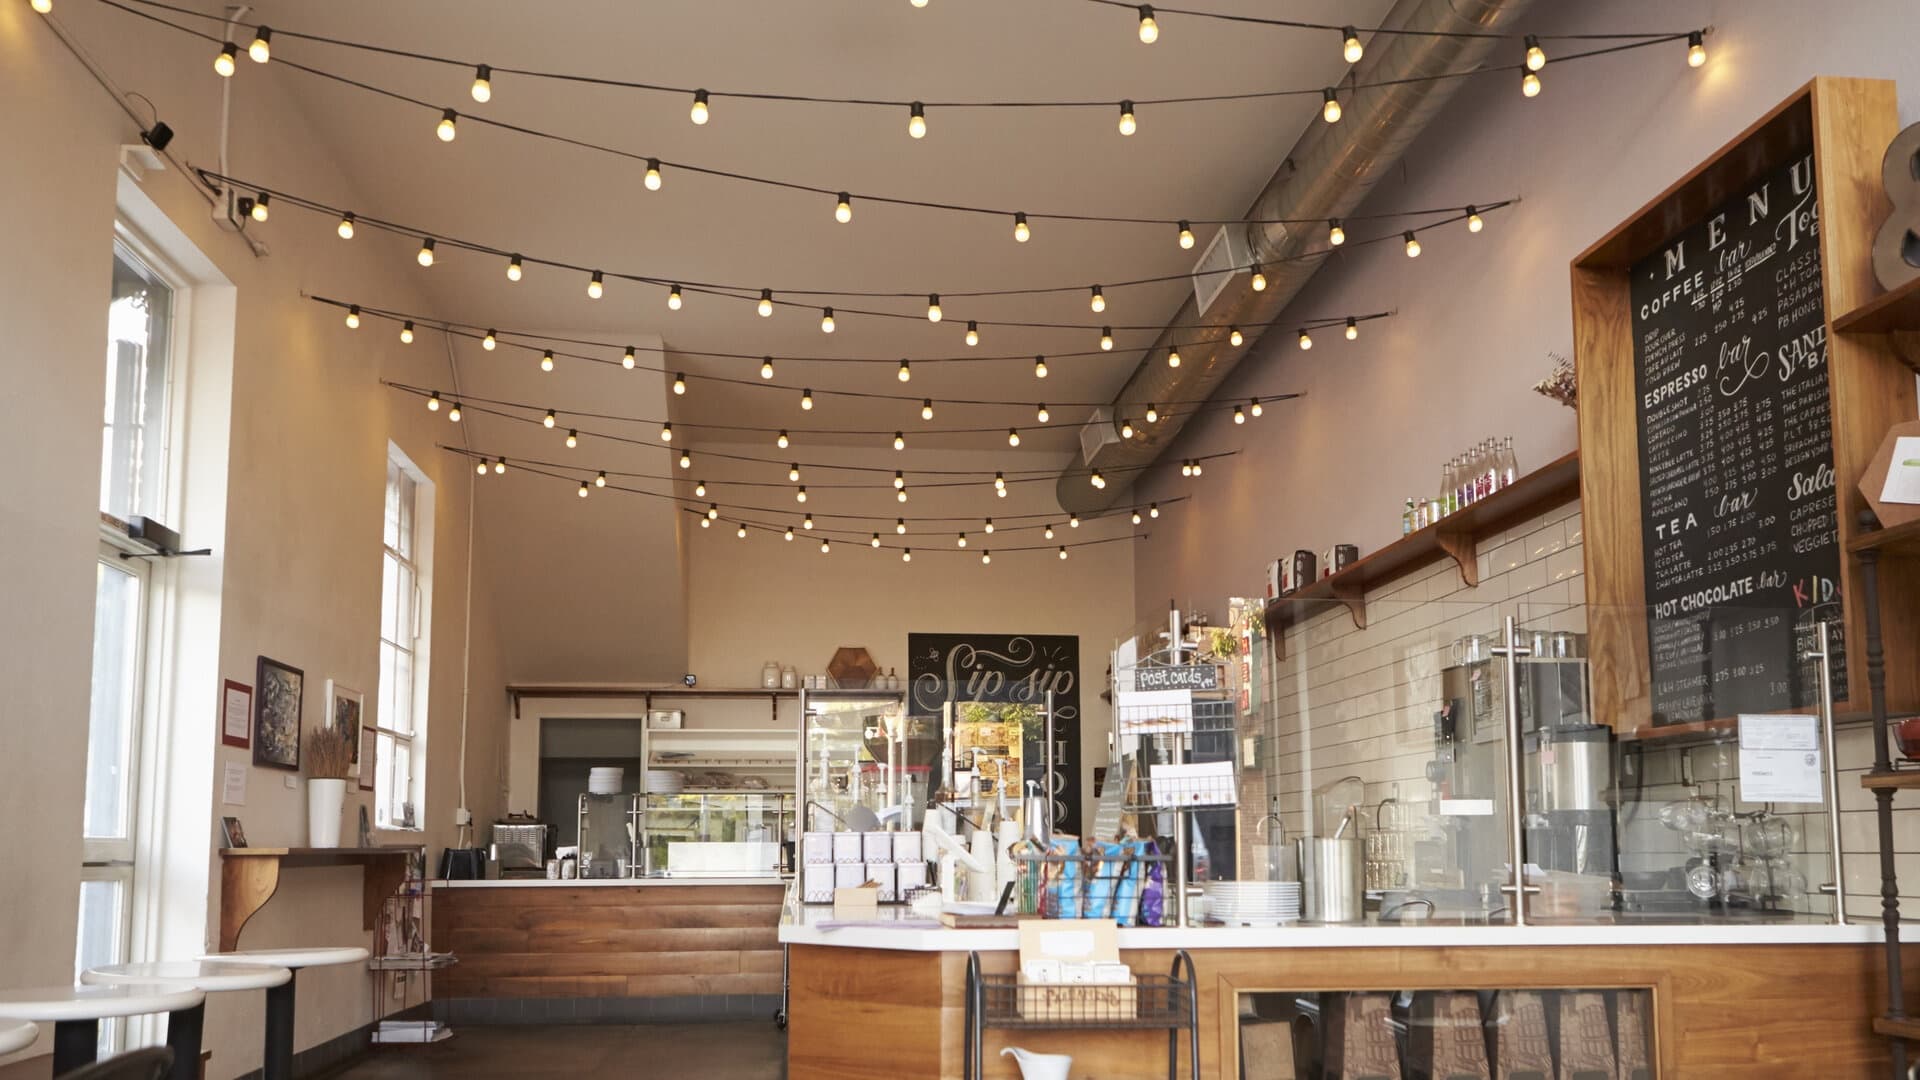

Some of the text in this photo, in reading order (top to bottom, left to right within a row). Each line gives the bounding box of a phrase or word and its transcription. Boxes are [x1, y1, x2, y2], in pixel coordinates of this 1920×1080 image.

[1662, 153, 1812, 280] MENU
[1640, 270, 1703, 320] COFFEE
[1644, 364, 1707, 409] ESPRESSO
[1655, 487, 1758, 540] TEA bar
[1792, 532, 1830, 554] VEGGIE
[1655, 598, 1678, 620] HOT
[1680, 576, 1753, 612] CHOCOLATE
[914, 643, 1076, 714] Sip sip
